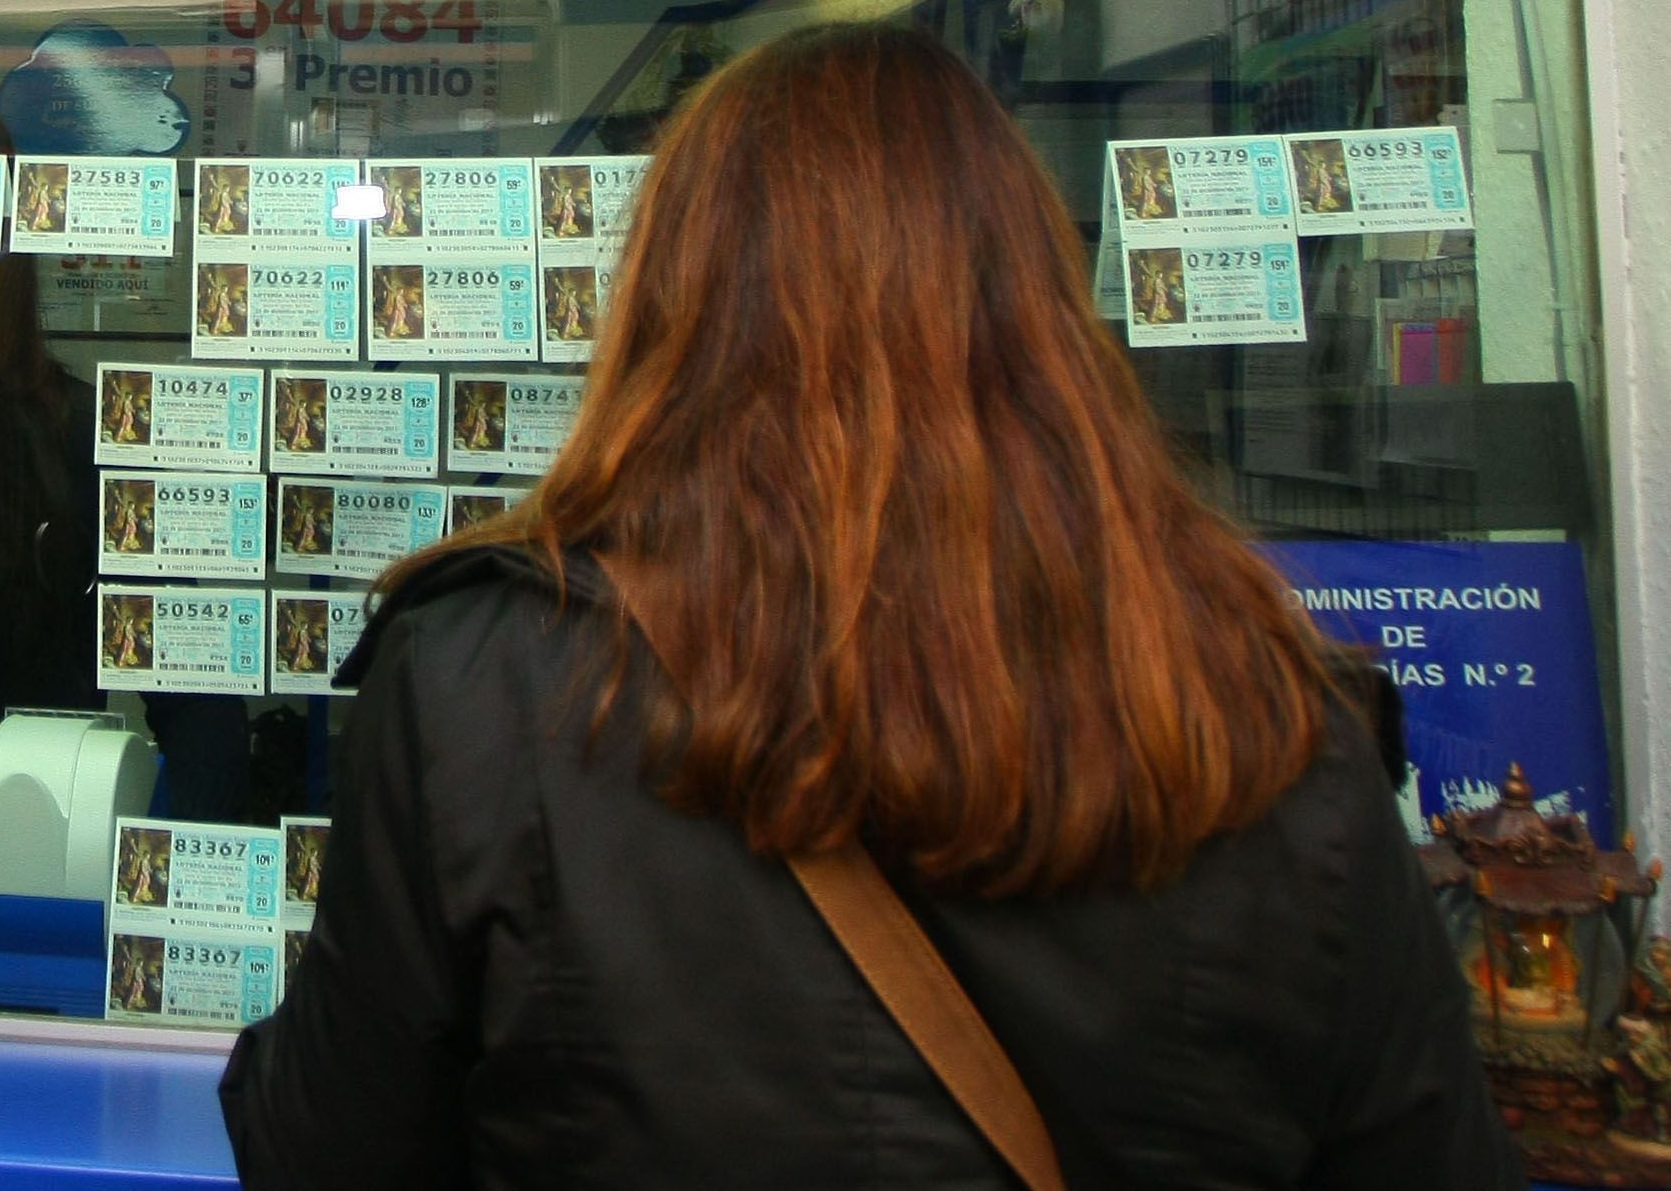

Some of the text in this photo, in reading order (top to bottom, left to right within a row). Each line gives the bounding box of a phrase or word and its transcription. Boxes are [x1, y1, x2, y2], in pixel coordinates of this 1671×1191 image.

[295, 53, 473, 97] Premio
[1349, 142, 1423, 157] 66593
[1174, 149, 1248, 164] 07279
[71, 171, 140, 185] 27583
[254, 172, 323, 185] 70622
[426, 172, 496, 185] 27806
[1267, 197, 1278, 205] 20
[1442, 191, 1454, 199] 20
[151, 219, 161, 227] 20
[336, 220, 345, 228] 20
[510, 219, 521, 227] 20
[1188, 252, 1261, 267] 07279
[57, 277, 150, 290] VENDIDO AQUÍ
[253, 271, 322, 284] 70622
[428, 272, 499, 285] 27806
[335, 321, 345, 329] 20
[512, 322, 523, 330] 20
[159, 379, 228, 395] 10474
[331, 387, 402, 401] 02928
[237, 433, 248, 441] 20
[414, 439, 425, 447] 20
[159, 488, 230, 502] 66593
[339, 494, 410, 509] 80080
[242, 540, 252, 548] 20
[1285, 583, 1541, 611] DMINISTRACIÓN
[158, 603, 228, 617] 50542
[1382, 625, 1427, 649] DE
[240, 656, 251, 664] 20
[1517, 664, 1536, 687] 2
[175, 839, 247, 857] 83367
[256, 898, 267, 906] 20
[169, 947, 241, 964] 83367
[251, 1004, 261, 1014] 20
